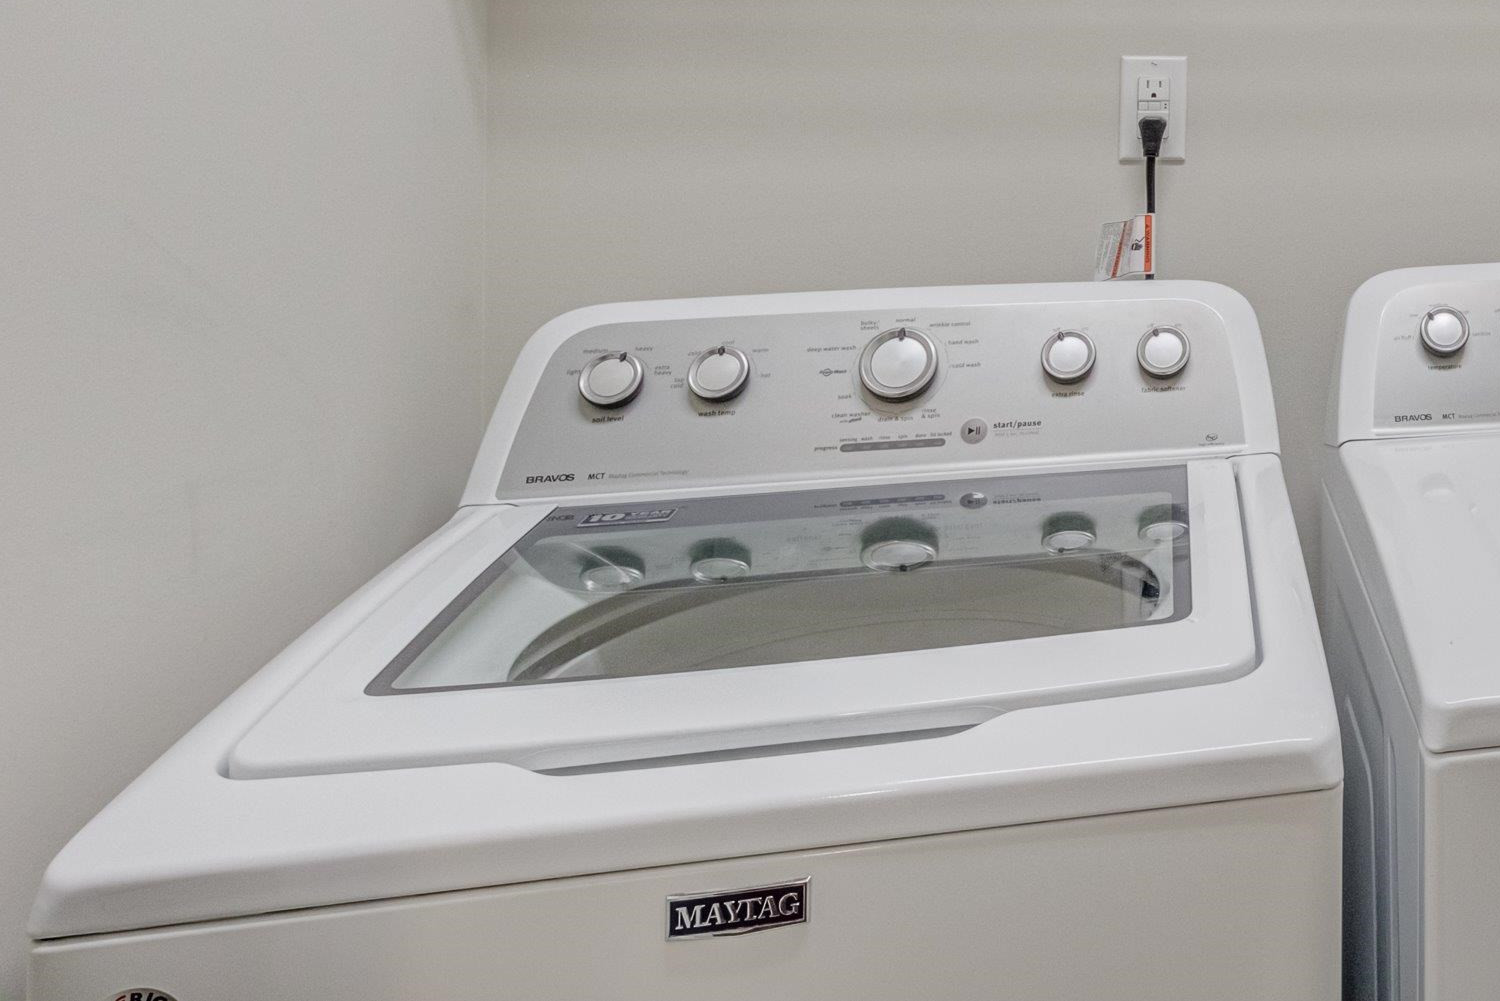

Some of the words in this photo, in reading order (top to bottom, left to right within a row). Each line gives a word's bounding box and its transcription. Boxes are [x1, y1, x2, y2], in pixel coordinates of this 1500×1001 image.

[698, 409, 717, 417] wash
[717, 409, 736, 417] temp
[1394, 413, 1433, 423] BRAVOS
[591, 415, 606, 424] soil
[607, 415, 625, 423] level
[993, 419, 1042, 430] start/pause
[814, 444, 838, 452] progress
[525, 473, 575, 484] BRAVOS
[587, 472, 605, 480] MCT
[675, 892, 800, 931] MAYTAG
